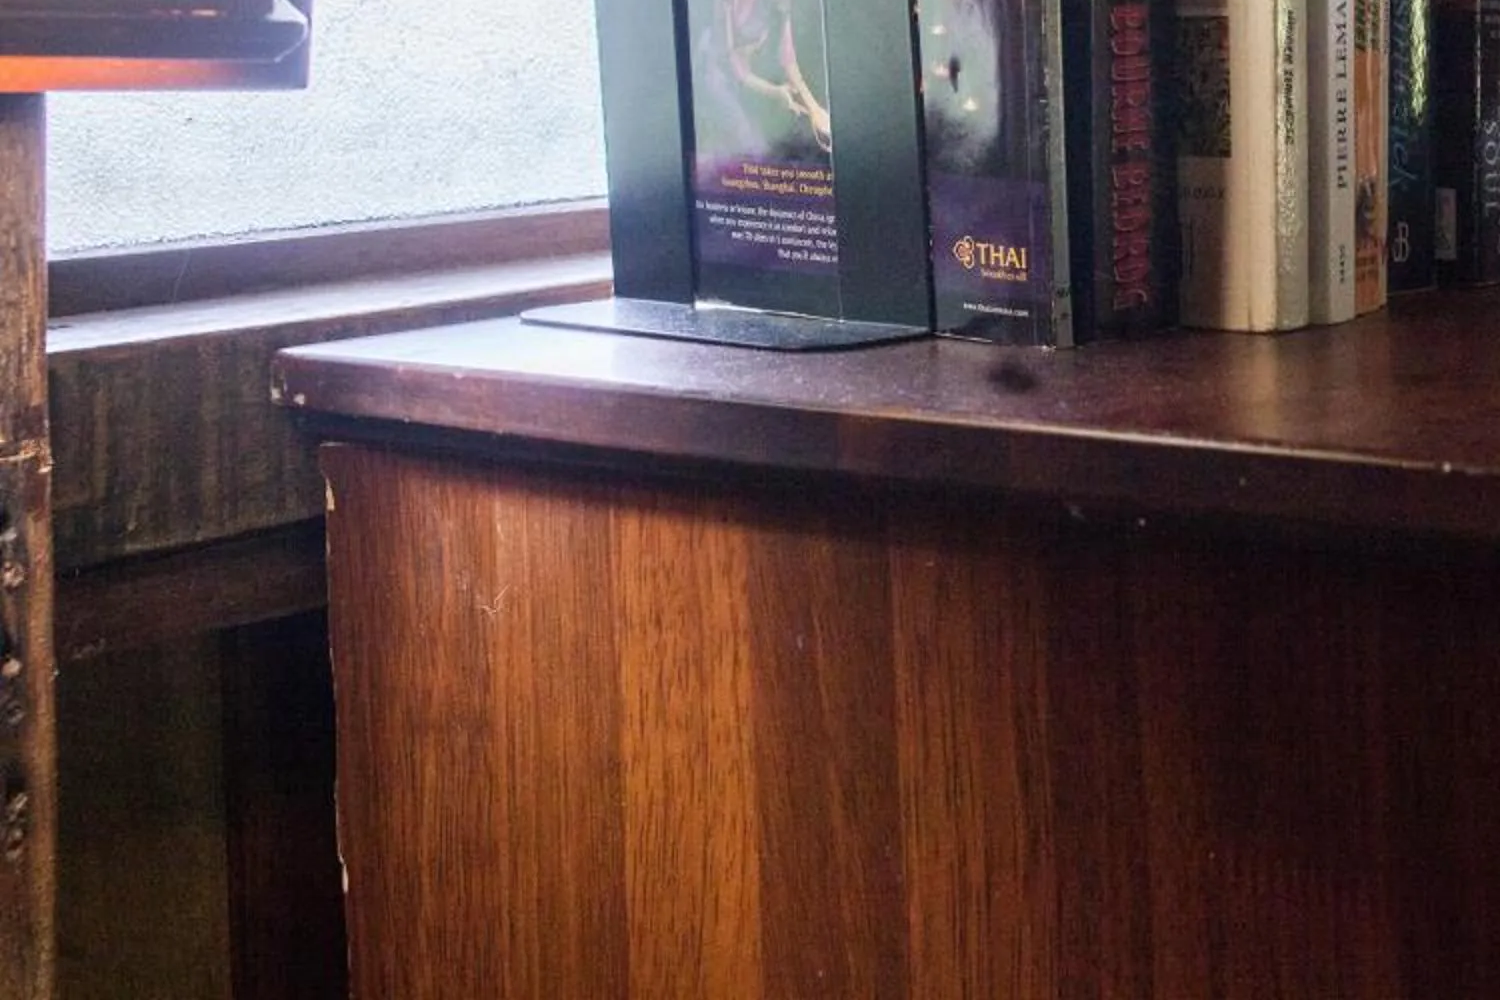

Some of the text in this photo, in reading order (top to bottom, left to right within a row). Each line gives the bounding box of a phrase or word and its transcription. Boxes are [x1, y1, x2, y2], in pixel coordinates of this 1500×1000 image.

[1335, 87, 1349, 190] PIERRE
[1483, 119, 1499, 218] SOUL
[975, 242, 1028, 270] THAI
